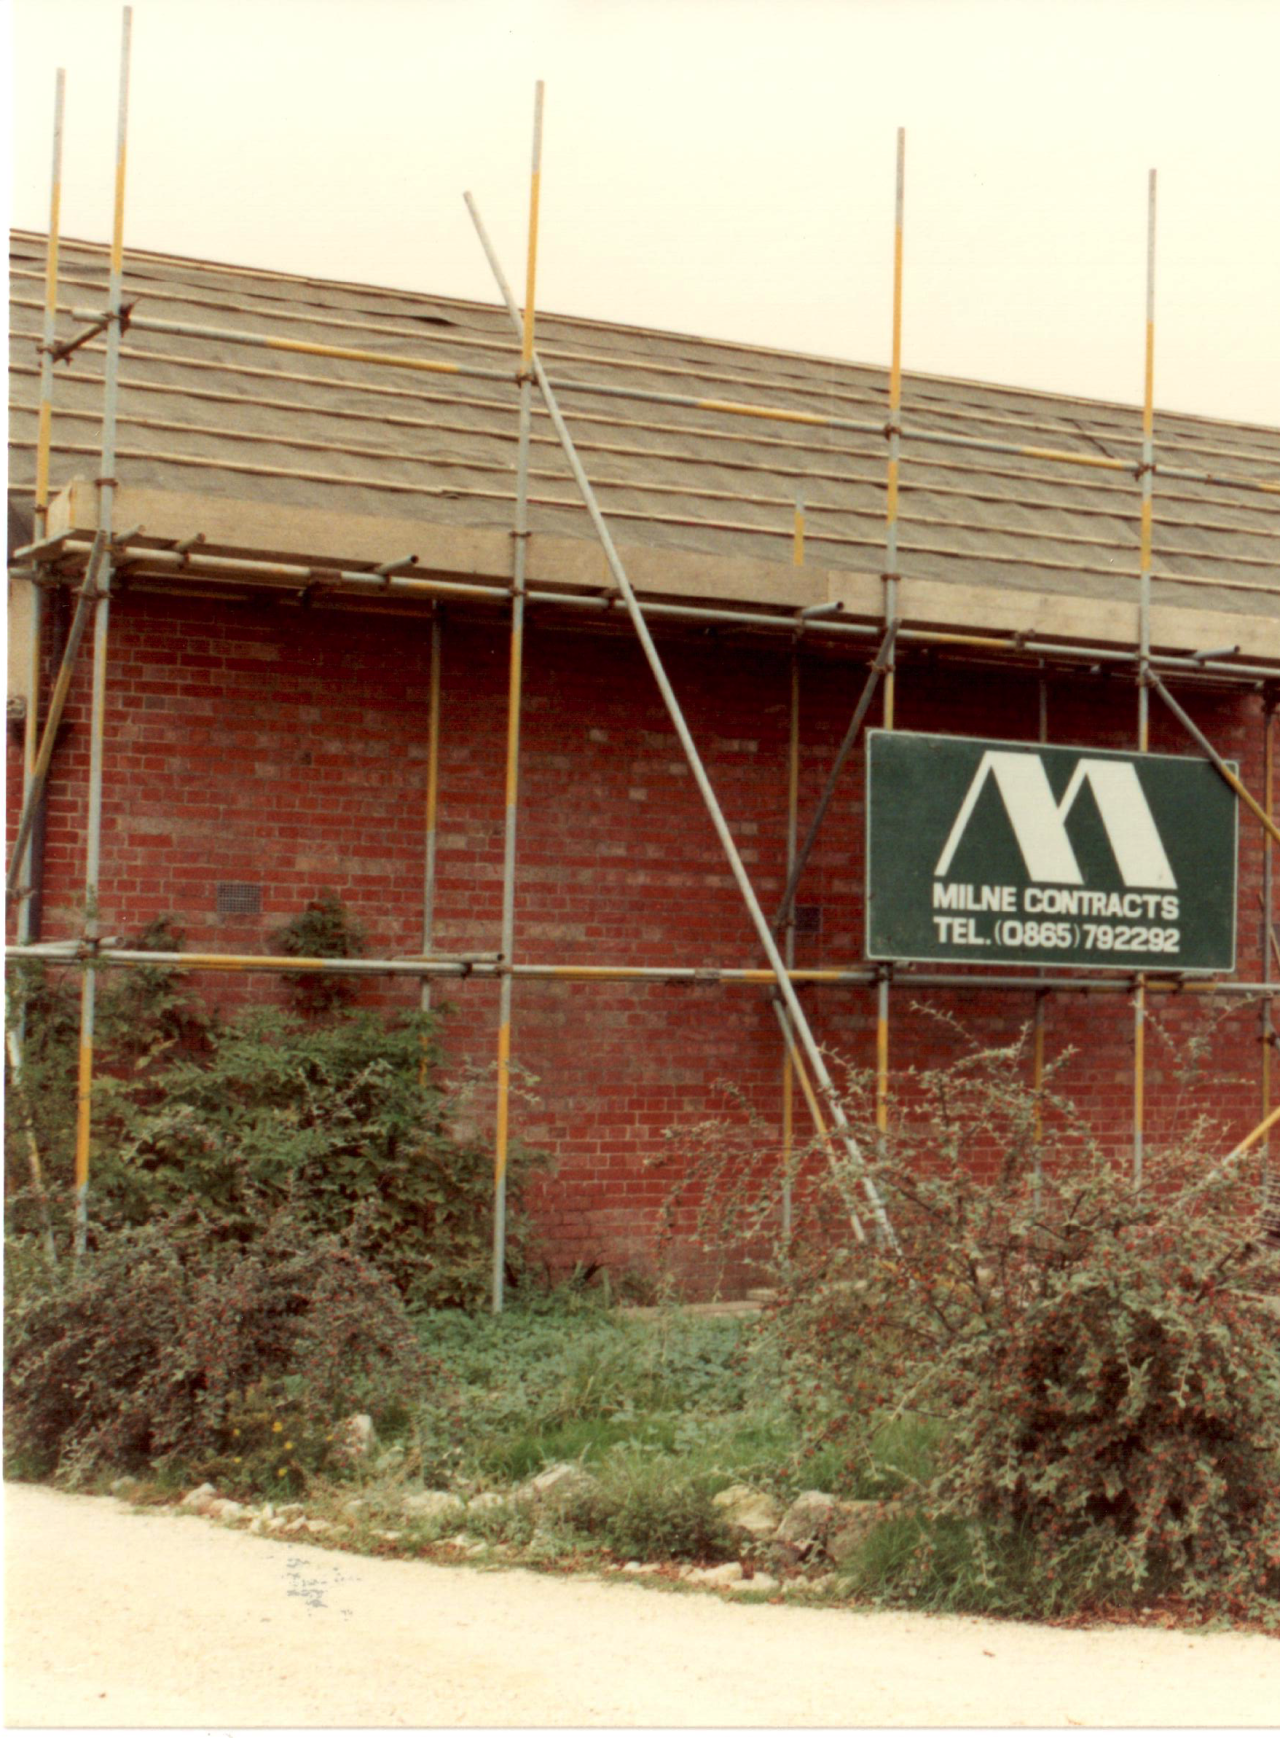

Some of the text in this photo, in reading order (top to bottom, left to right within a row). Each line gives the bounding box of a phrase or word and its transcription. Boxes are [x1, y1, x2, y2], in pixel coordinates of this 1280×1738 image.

[933, 883, 1179, 920] MILNE CONTRACTS
[934, 917, 1180, 953] TEL. (0865) 792292
